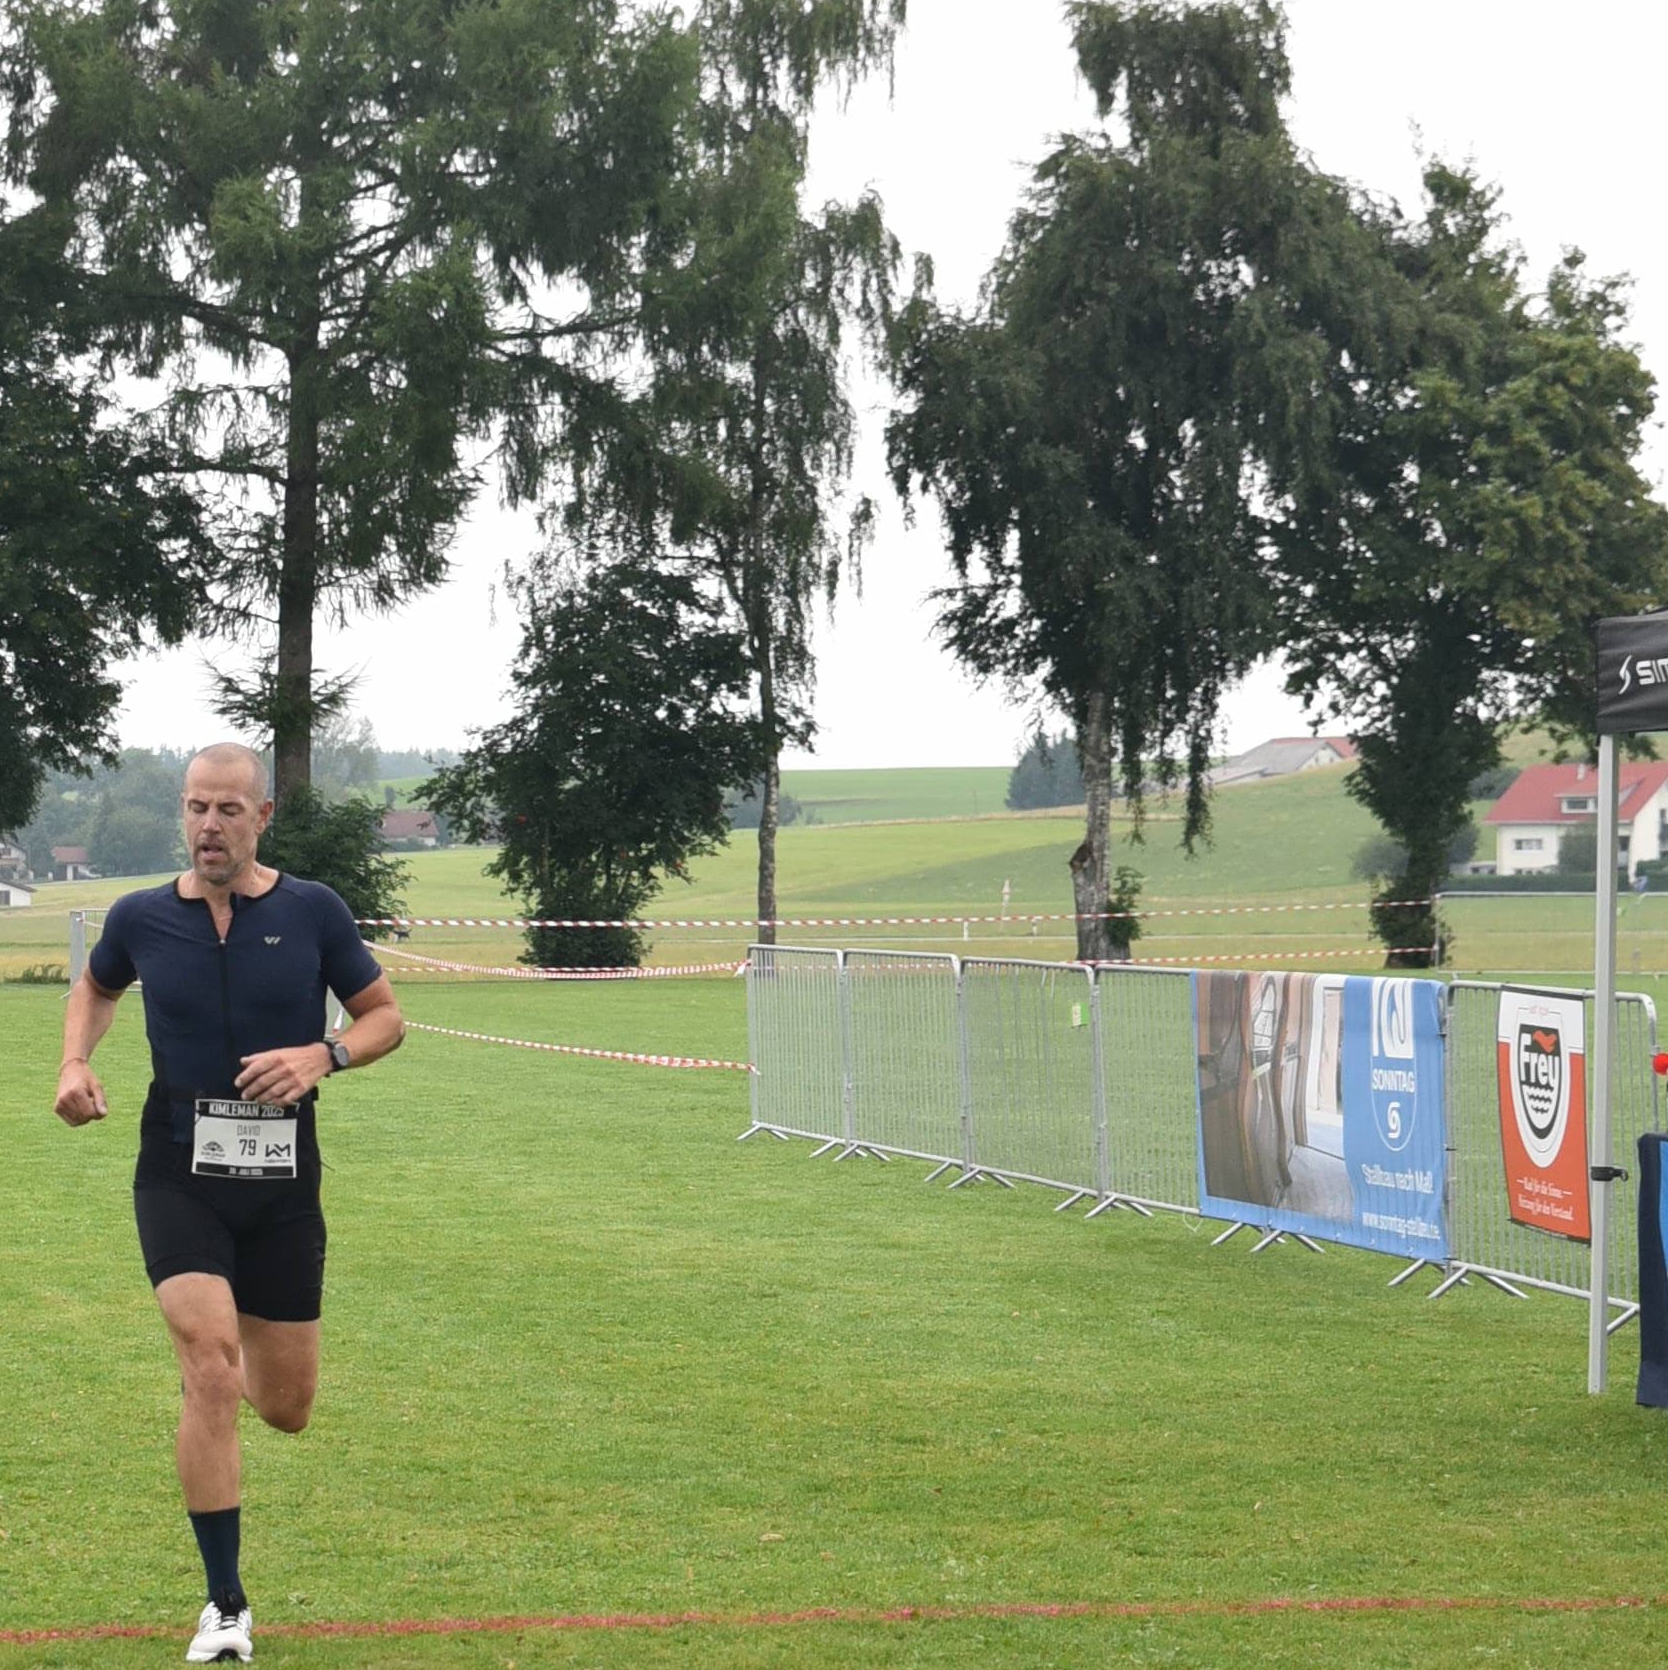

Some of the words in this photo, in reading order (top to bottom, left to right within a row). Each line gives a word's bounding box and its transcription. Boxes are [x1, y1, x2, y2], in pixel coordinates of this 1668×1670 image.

[1371, 1069, 1415, 1093] SONNTAG
[208, 1102, 259, 1117] KIMLEMAN
[236, 1124, 261, 1136] DAVID
[238, 1139, 257, 1156] 79
